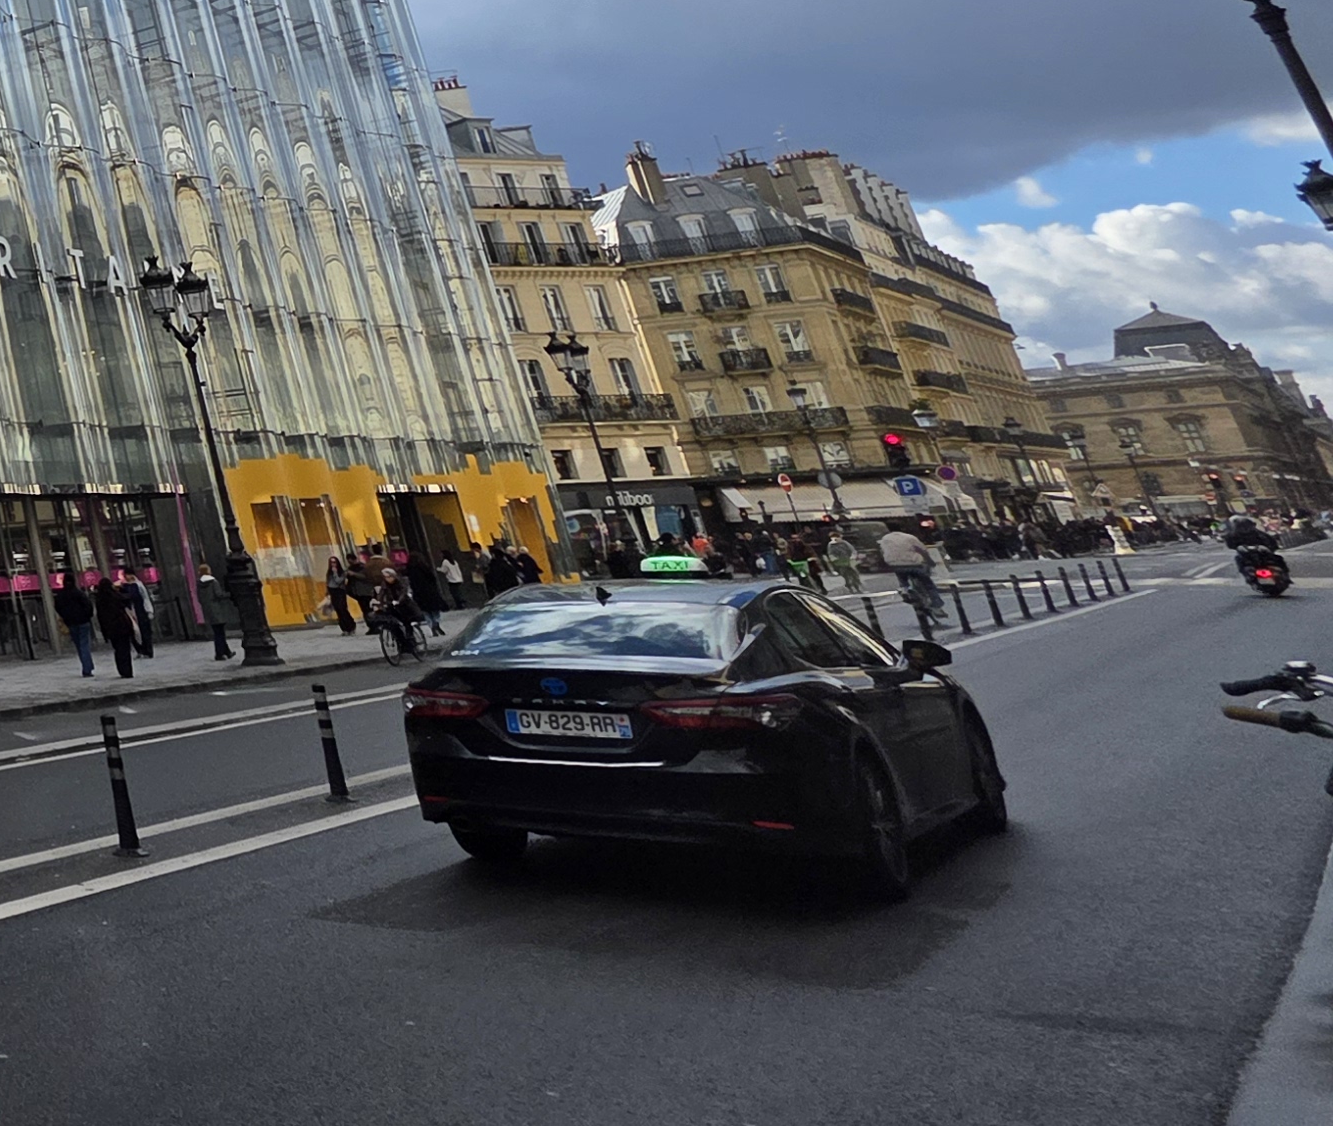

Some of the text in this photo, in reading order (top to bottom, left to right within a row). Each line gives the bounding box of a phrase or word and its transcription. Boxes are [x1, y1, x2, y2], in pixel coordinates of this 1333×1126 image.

[901, 481, 914, 494] P
[650, 560, 689, 570] TAXI
[518, 711, 617, 733] GV-829-RR
